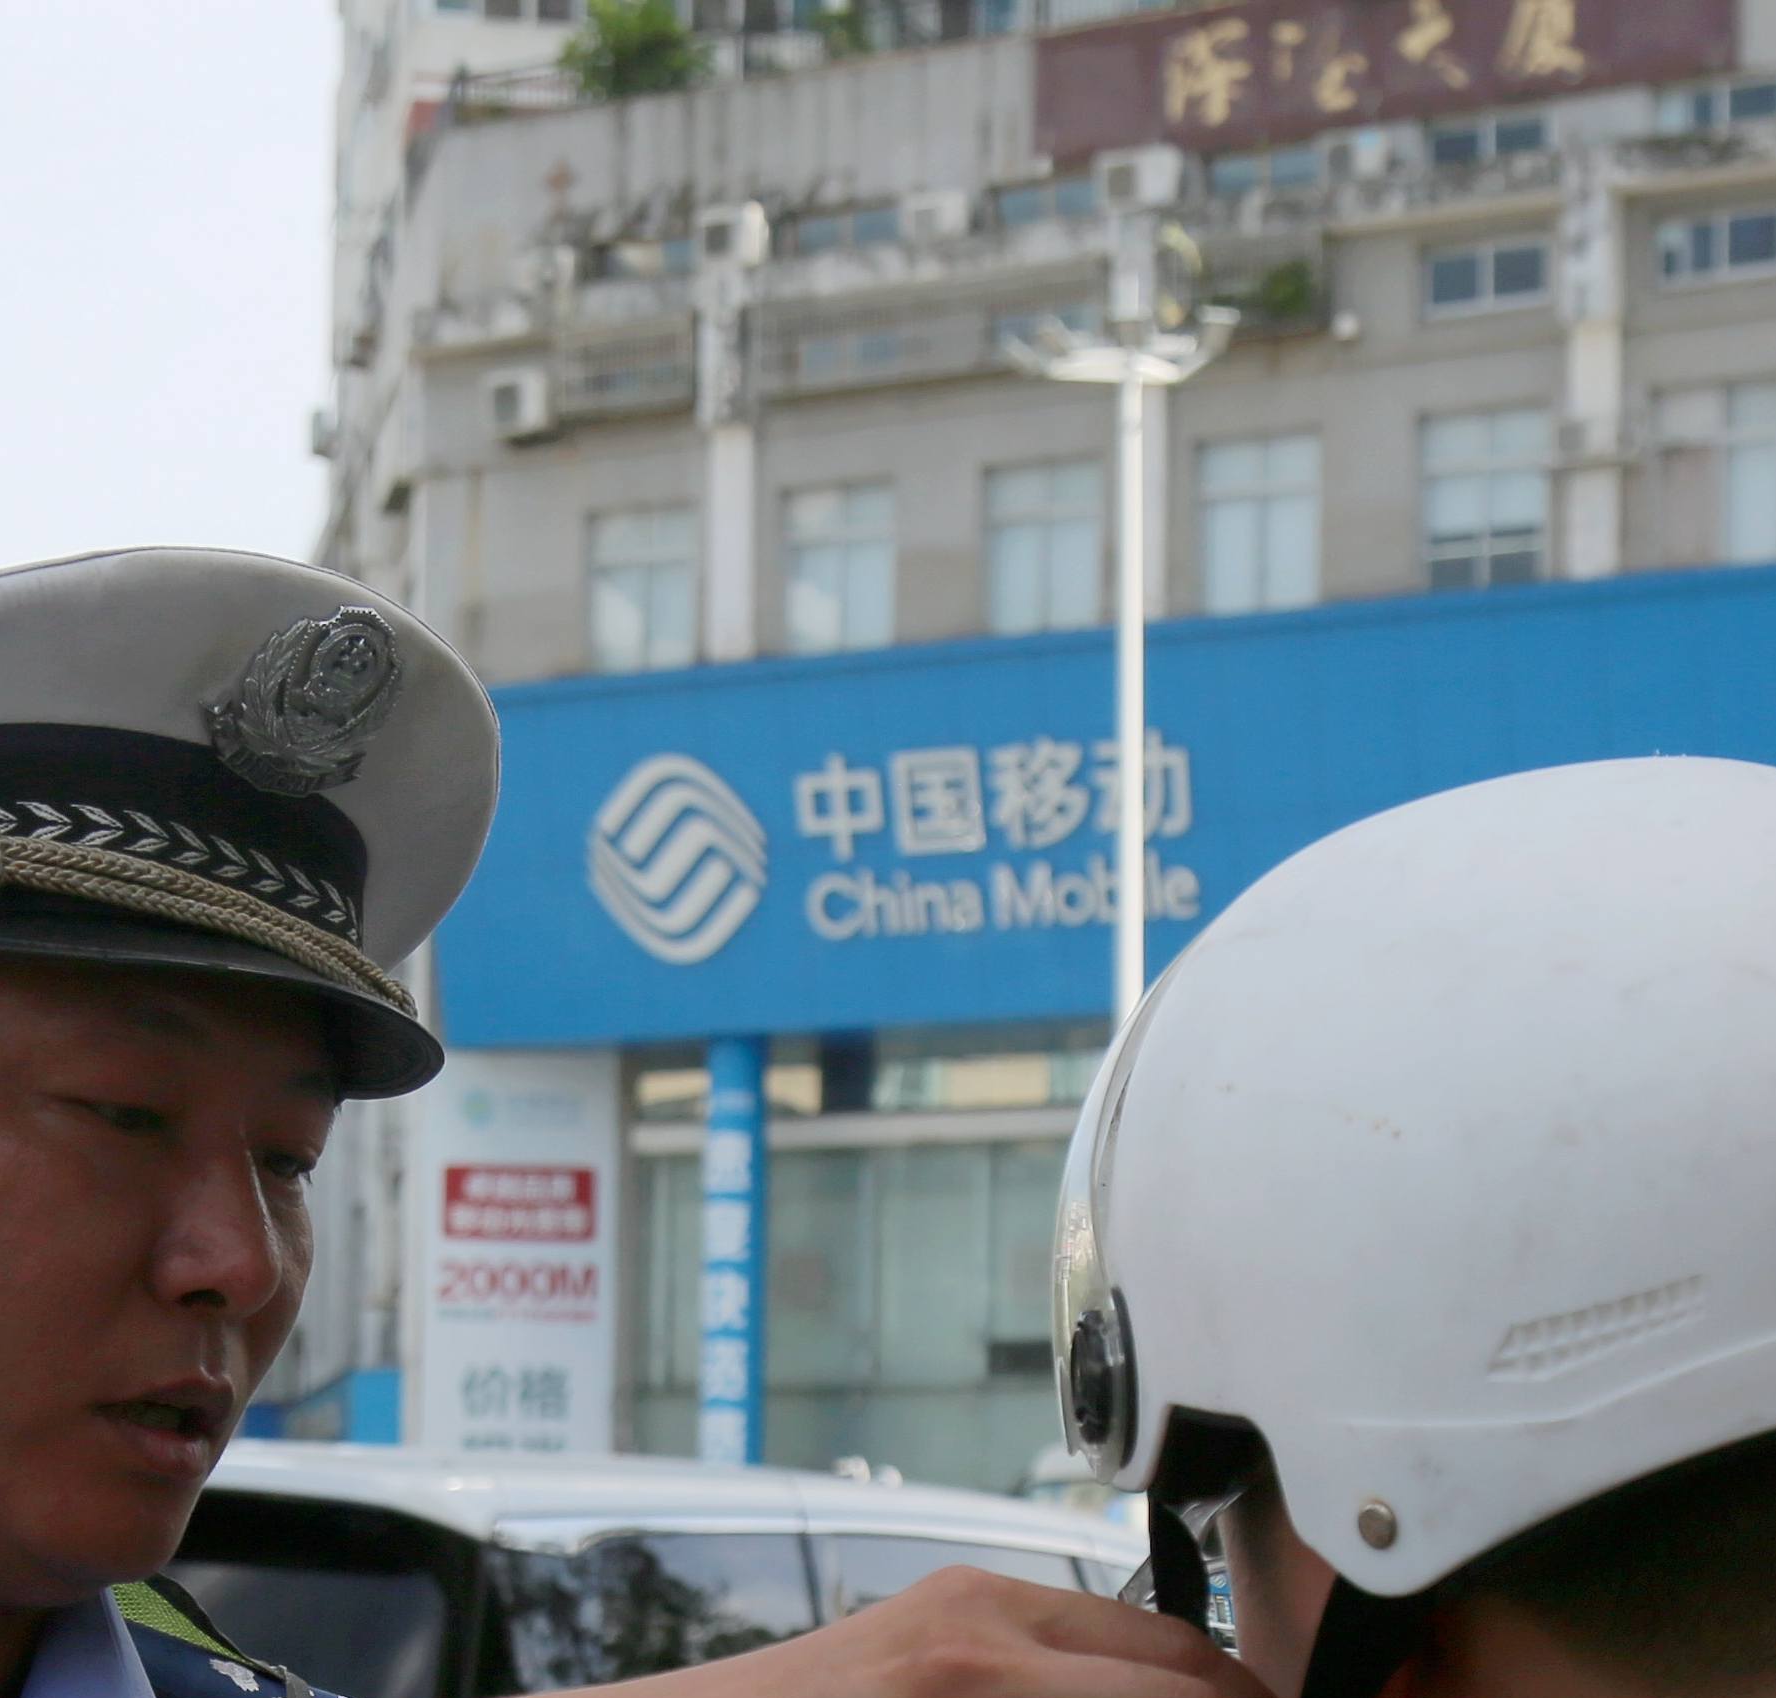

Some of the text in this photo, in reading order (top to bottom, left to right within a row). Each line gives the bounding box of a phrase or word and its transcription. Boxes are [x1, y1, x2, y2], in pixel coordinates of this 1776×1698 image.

[793, 730, 1193, 862] 中国移动
[805, 847, 1201, 941] China Moble
[436, 1258, 600, 1303] 2000M
